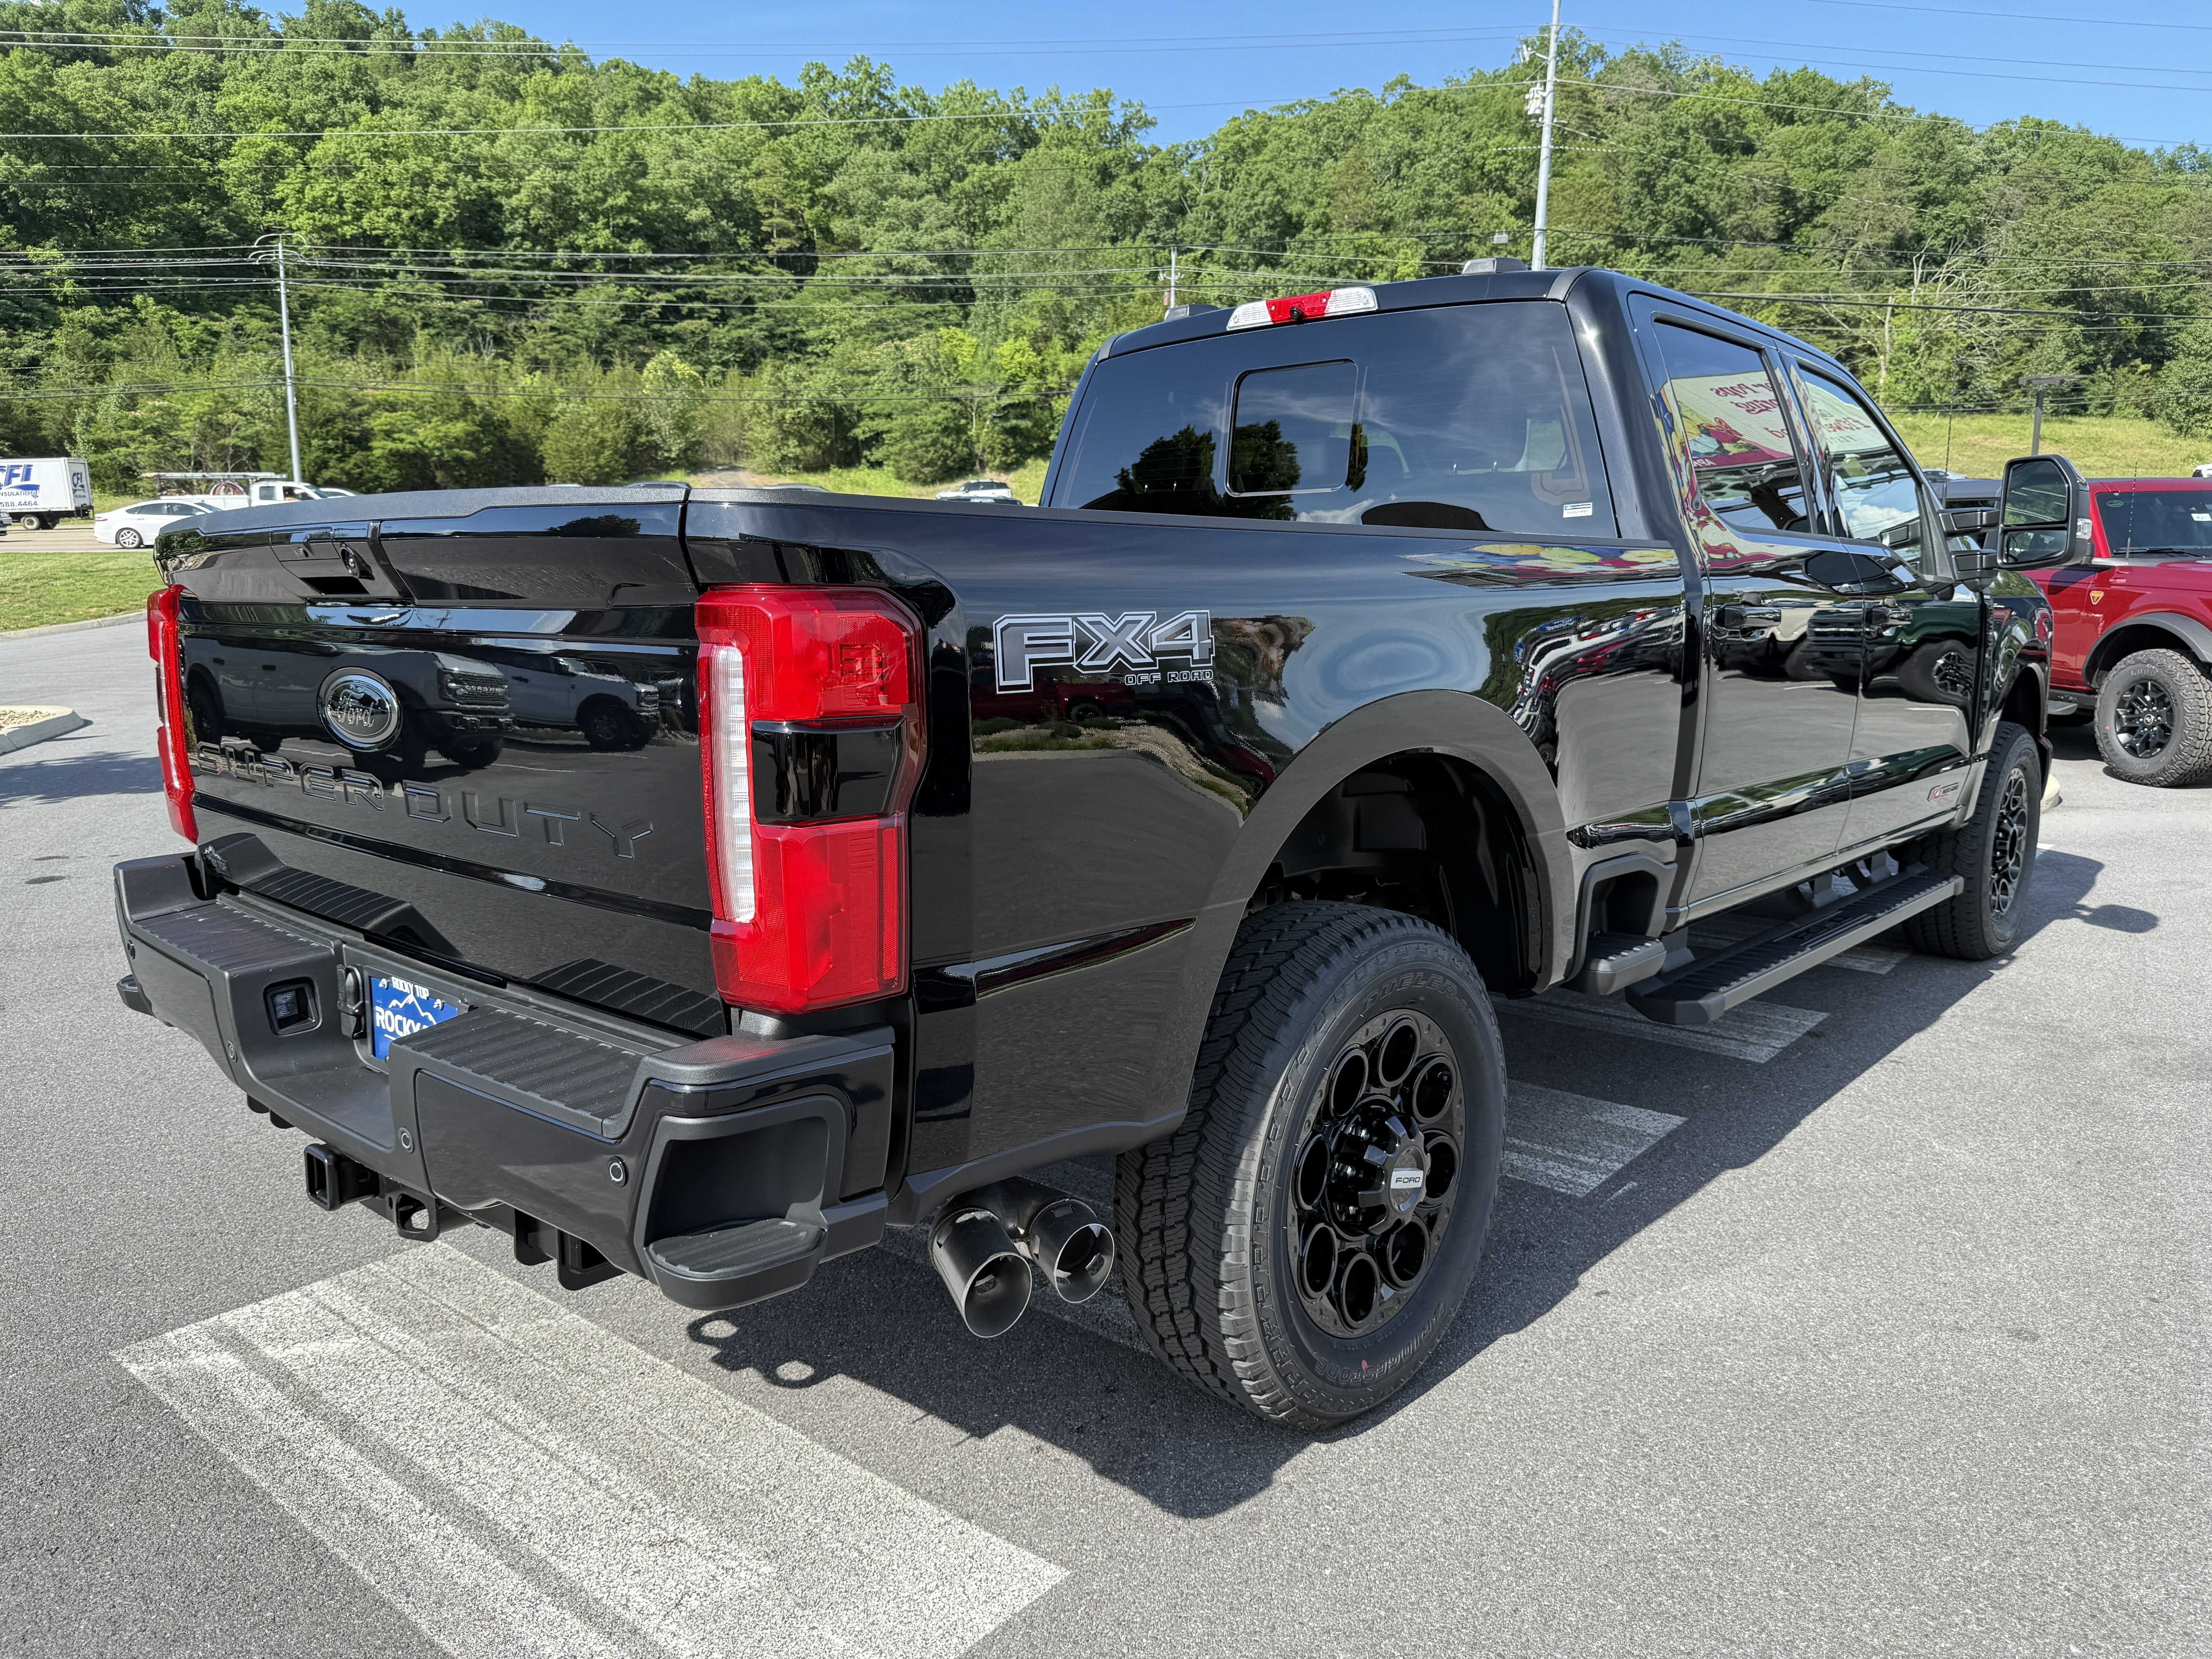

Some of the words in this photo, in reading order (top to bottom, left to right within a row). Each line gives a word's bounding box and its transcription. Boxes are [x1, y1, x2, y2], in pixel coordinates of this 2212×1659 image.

[993, 610, 1215, 694] FX4
[1124, 672, 1161, 686] OFF
[1167, 669, 1214, 683] ROAD
[336, 689, 375, 728] Ford
[196, 741, 384, 812] SUPER
[402, 779, 654, 859] DUTY
[391, 976, 414, 995] ROCKY
[414, 984, 429, 1000] TOP
[1360, 972, 1458, 1015] DUELER
[1314, 1301, 1444, 1384] BRIDGESTONE
